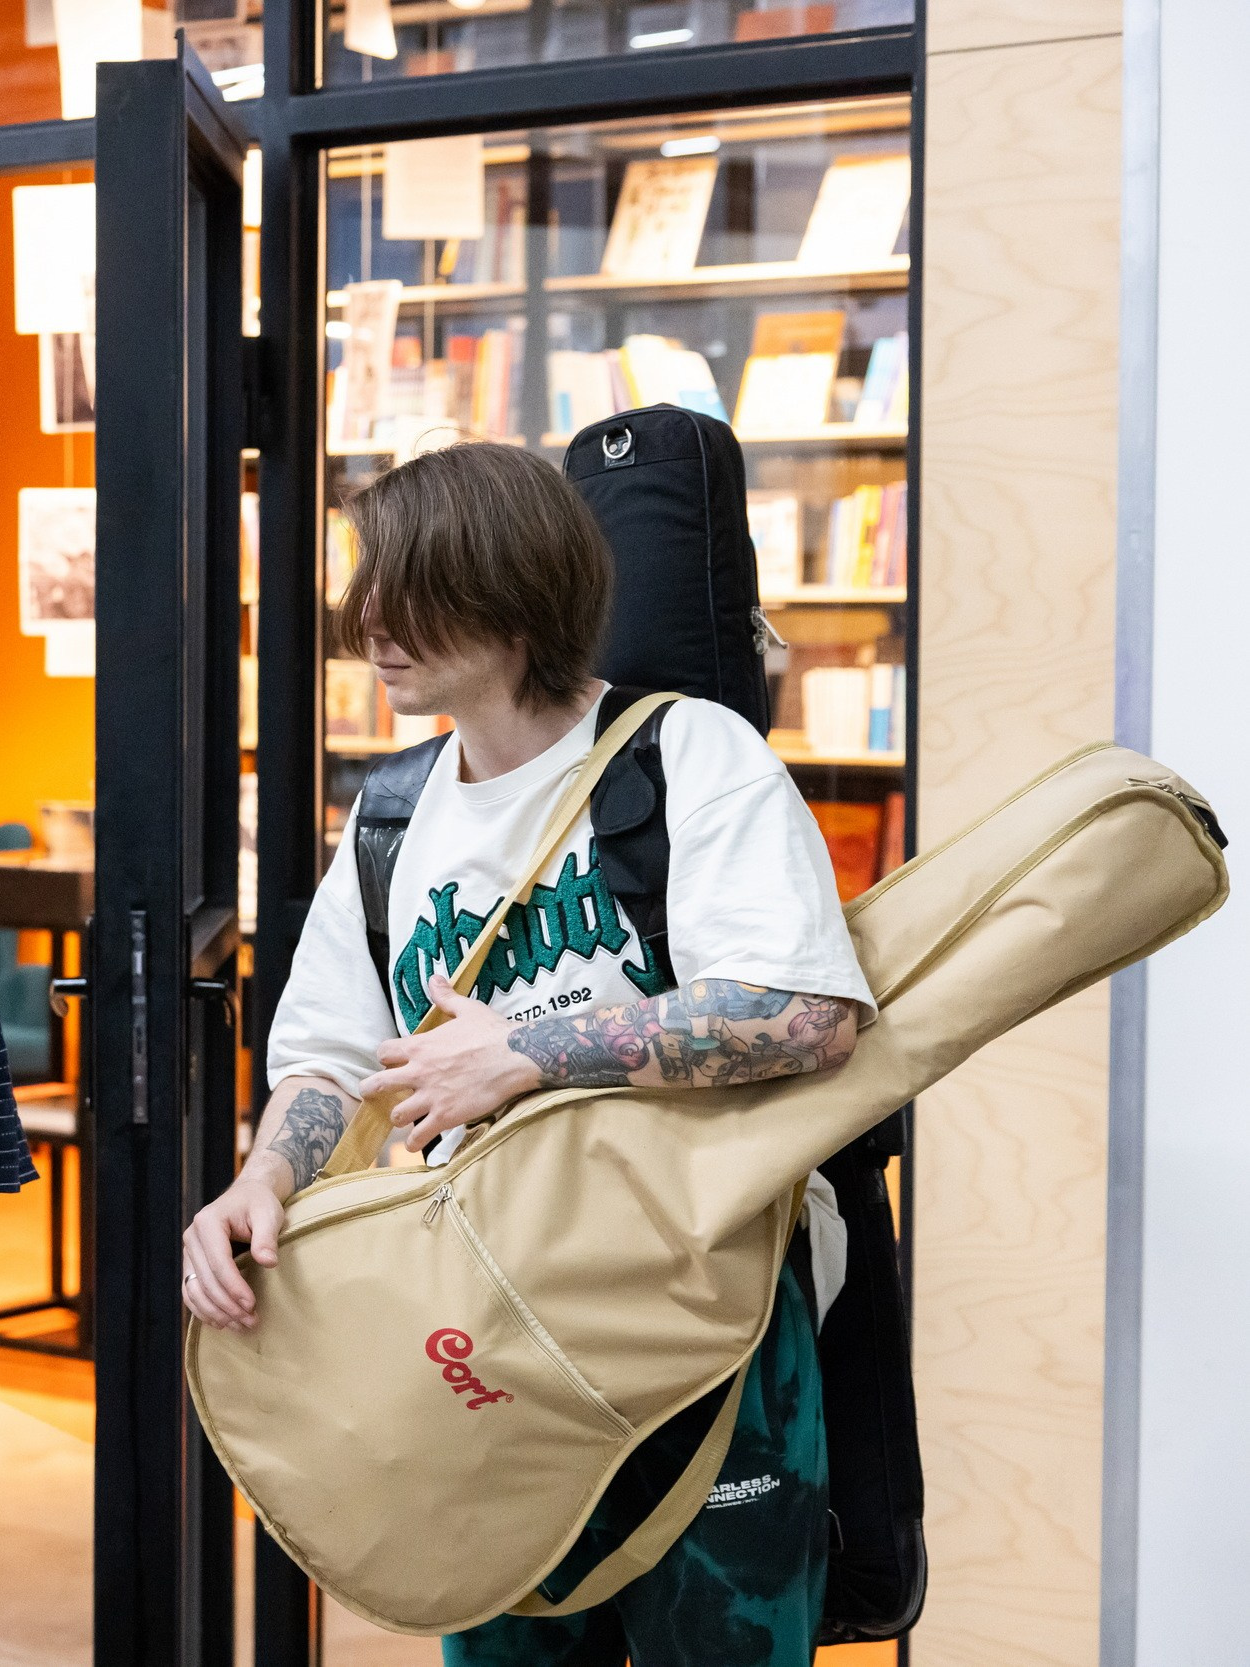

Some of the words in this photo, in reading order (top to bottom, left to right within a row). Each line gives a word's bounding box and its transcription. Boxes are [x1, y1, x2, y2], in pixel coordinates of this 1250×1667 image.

[506, 1005, 547, 1023] STD.
[548, 987, 593, 1011] 1992
[425, 1328, 510, 1410] Cort
[707, 1479, 780, 1503] NNECTION
[709, 1474, 772, 1493] ARLESS
